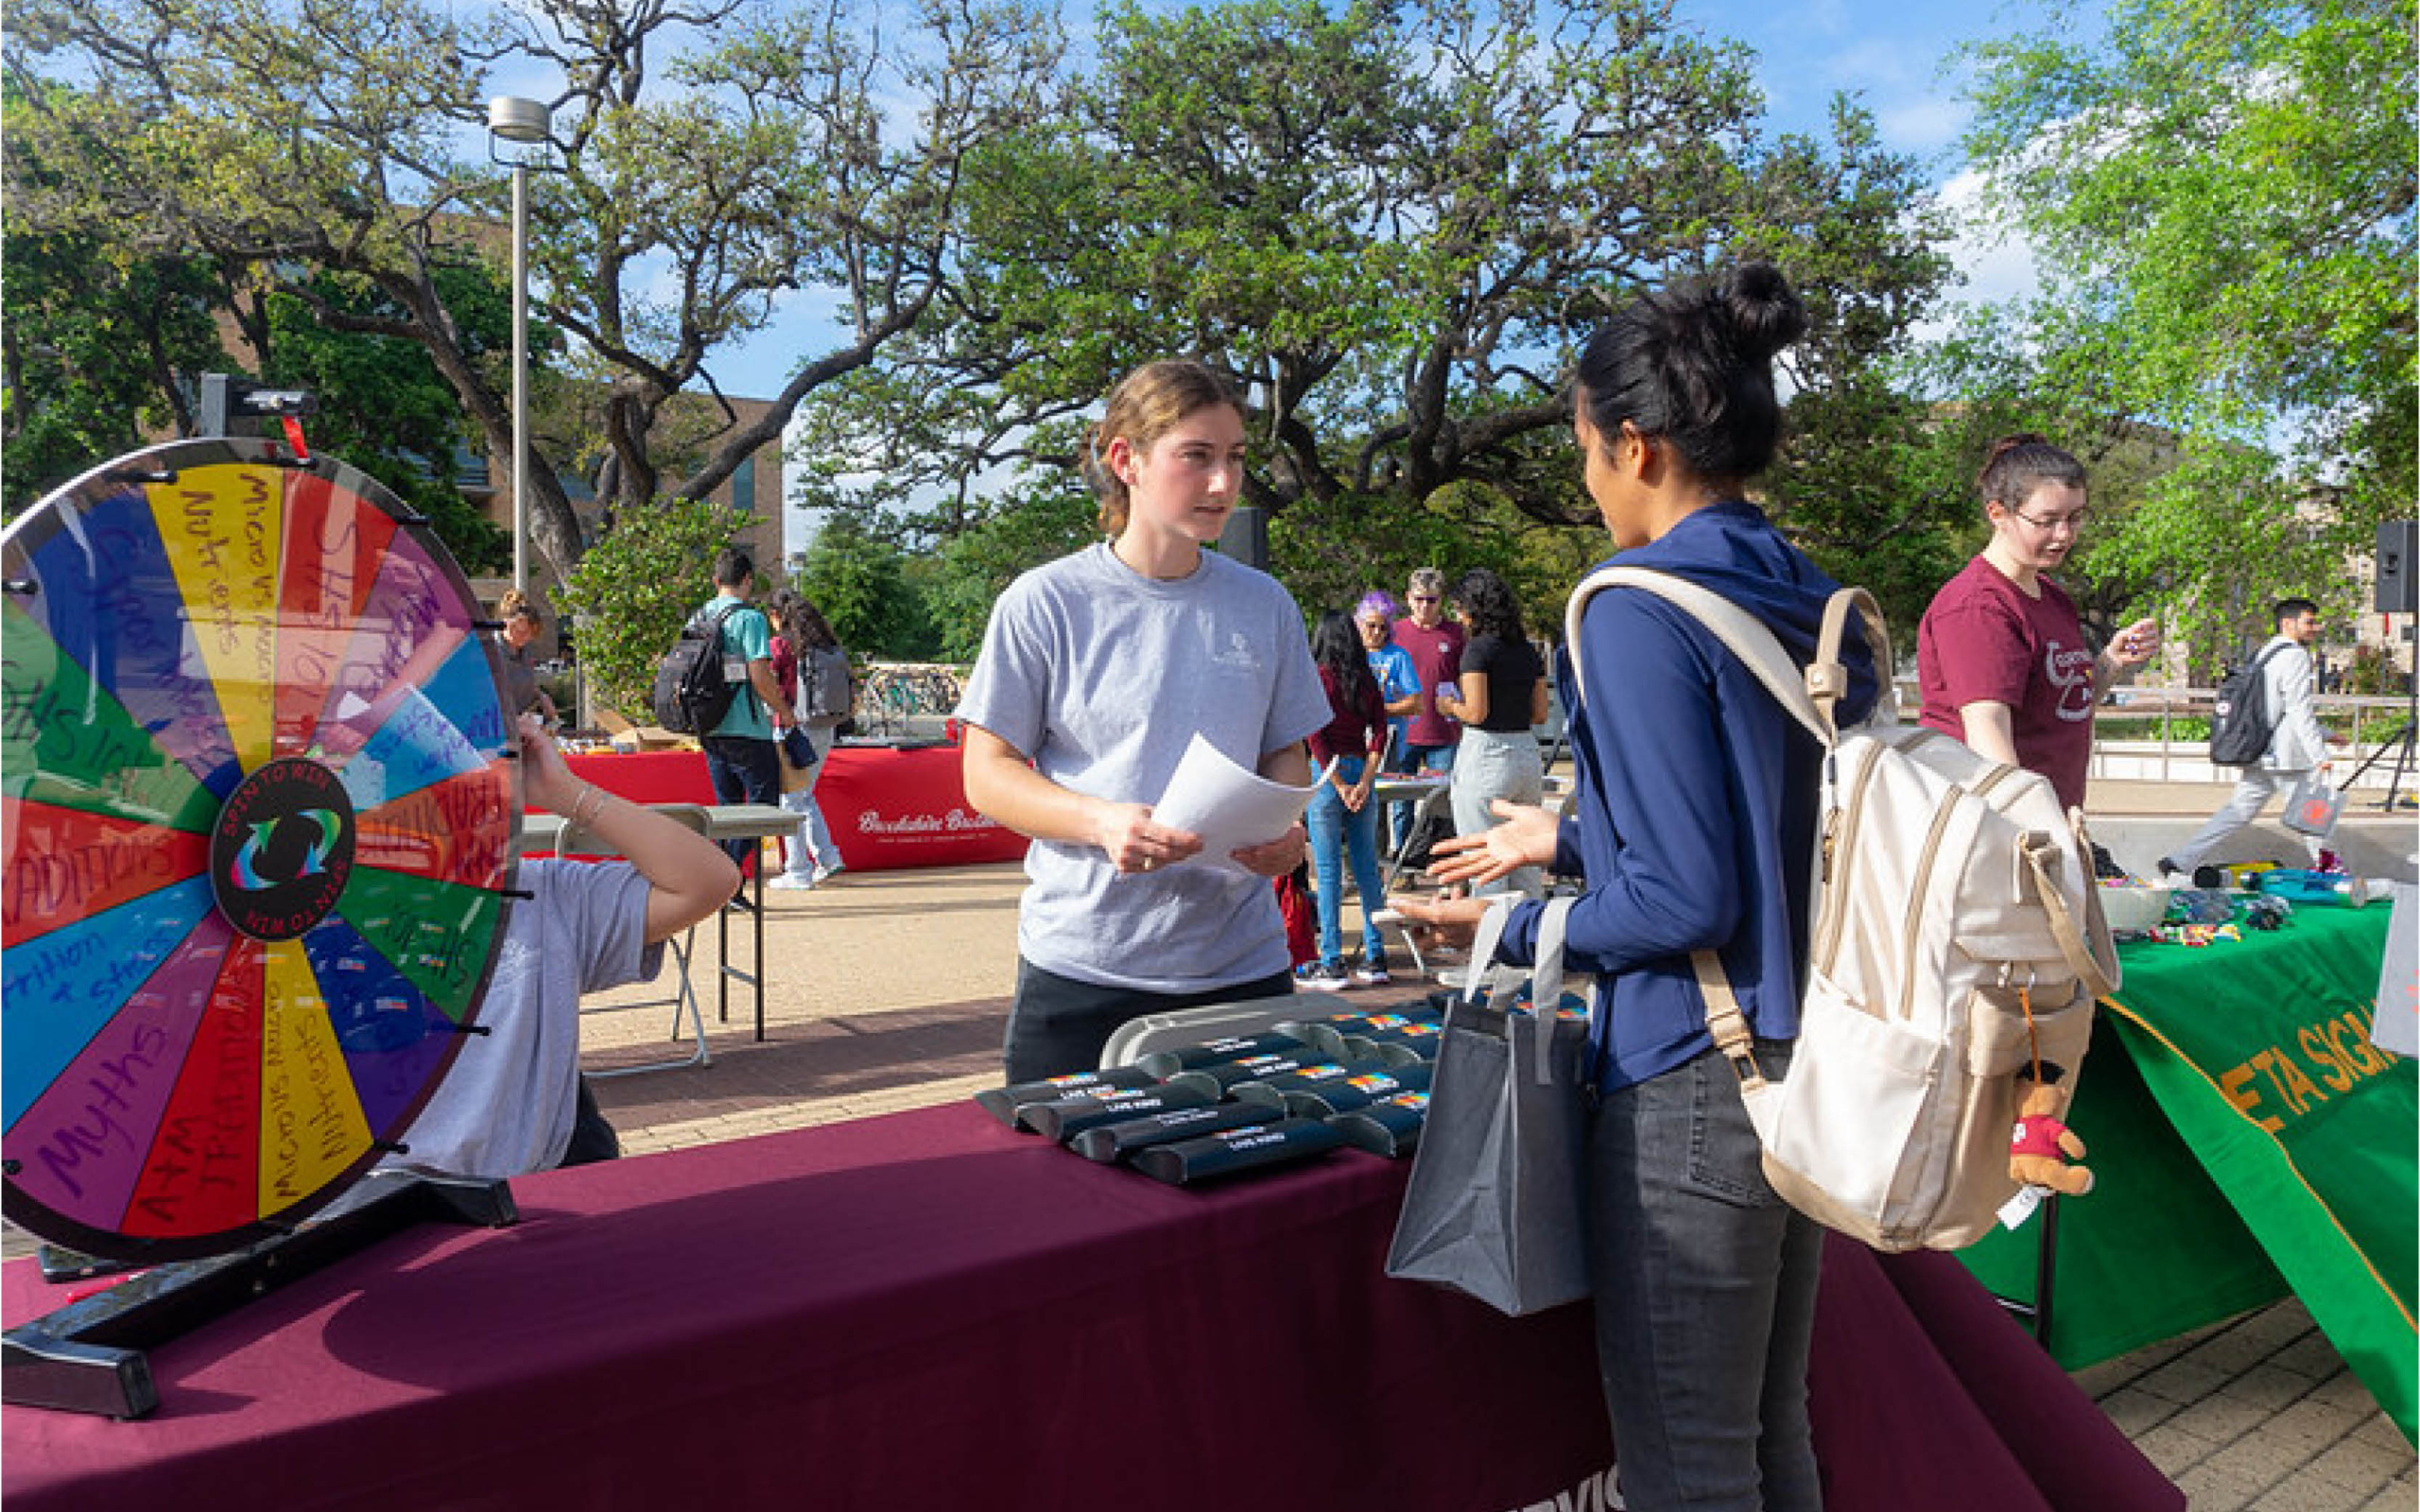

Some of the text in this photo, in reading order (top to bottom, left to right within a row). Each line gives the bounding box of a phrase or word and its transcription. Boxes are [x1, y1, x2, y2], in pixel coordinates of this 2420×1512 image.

[240, 472, 270, 567] Micro
[260, 765, 287, 786] TO
[291, 764, 330, 791] WIN
[37, 1022, 171, 1200] Myths
